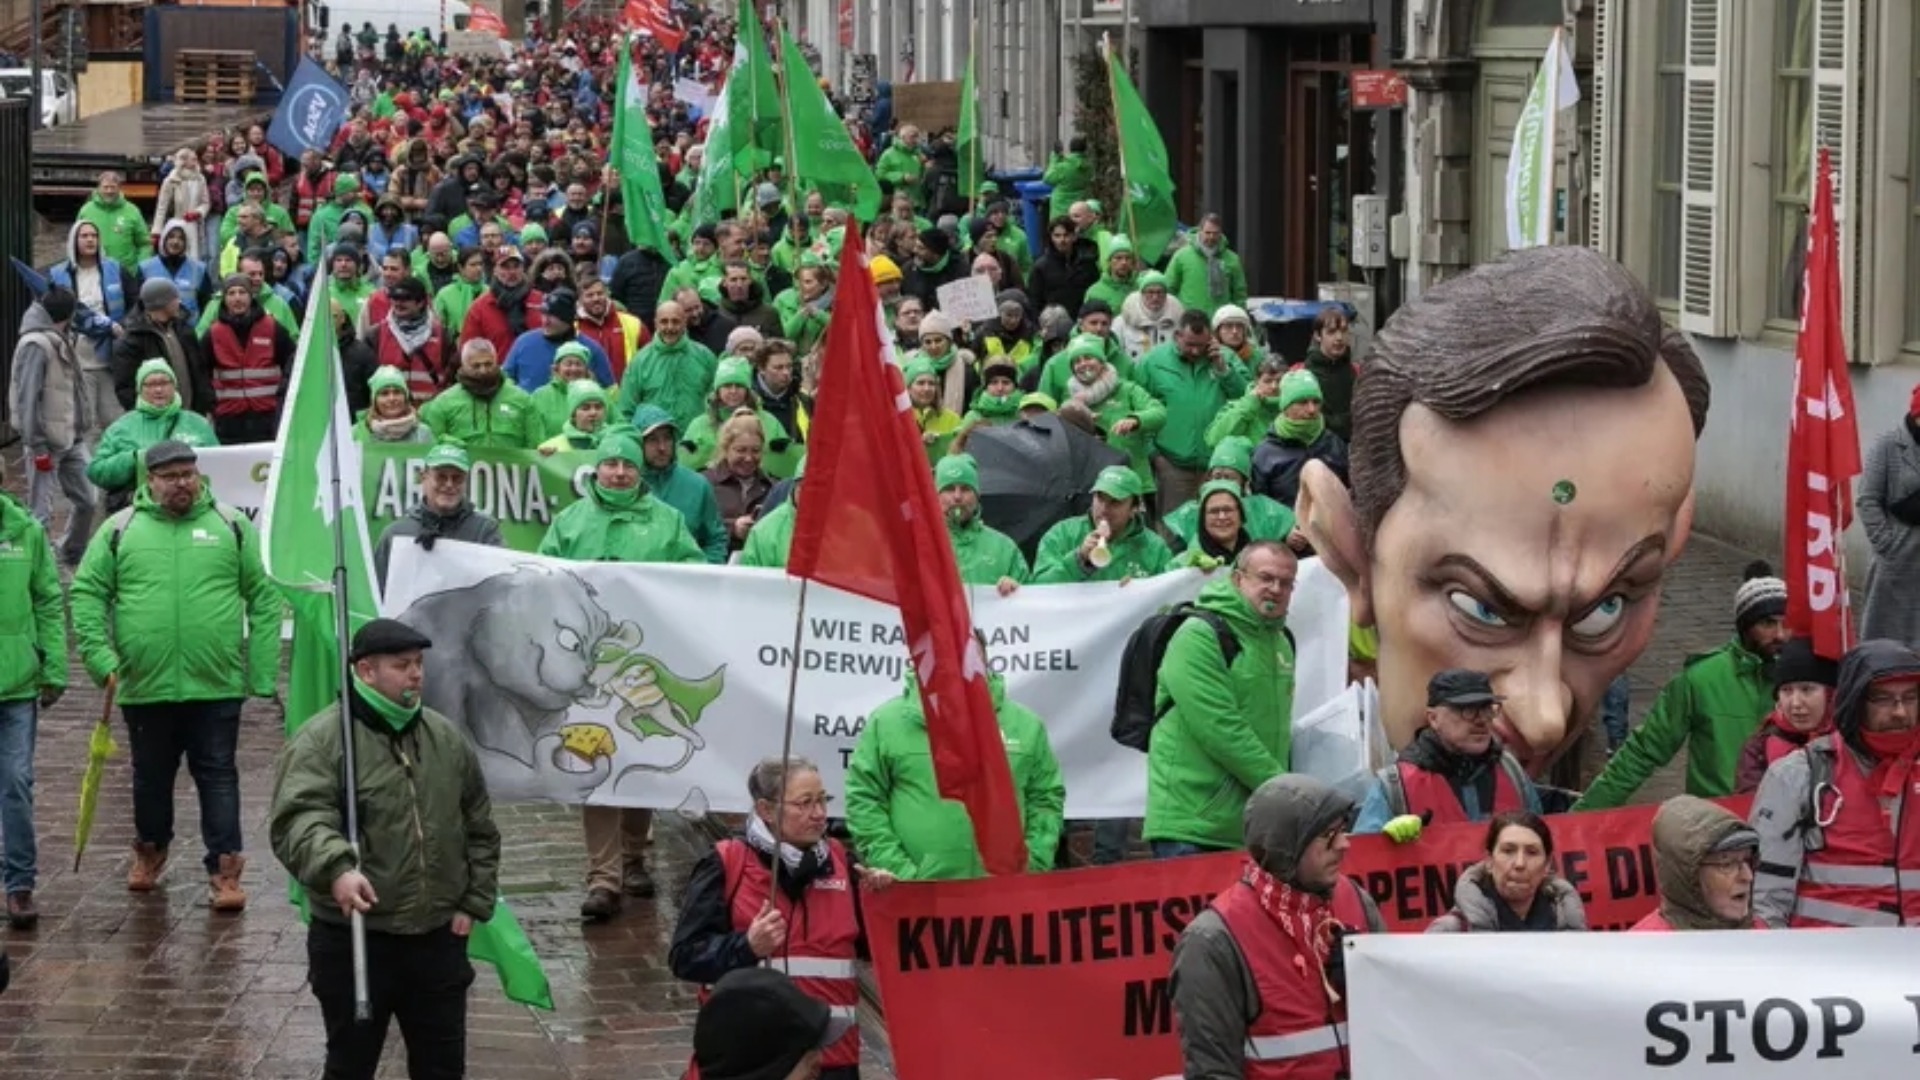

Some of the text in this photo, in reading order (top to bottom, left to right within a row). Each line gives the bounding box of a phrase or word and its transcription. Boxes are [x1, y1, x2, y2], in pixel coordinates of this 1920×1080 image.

[810, 617, 862, 643] WIE
[872, 623, 906, 646] RA
[814, 713, 867, 737] RAA
[838, 748, 855, 770] T
[897, 892, 1217, 972] KWALITEITS
[1605, 844, 1658, 900] DI
[1122, 977, 1173, 1037] M
[1645, 997, 1865, 1066] STOP
